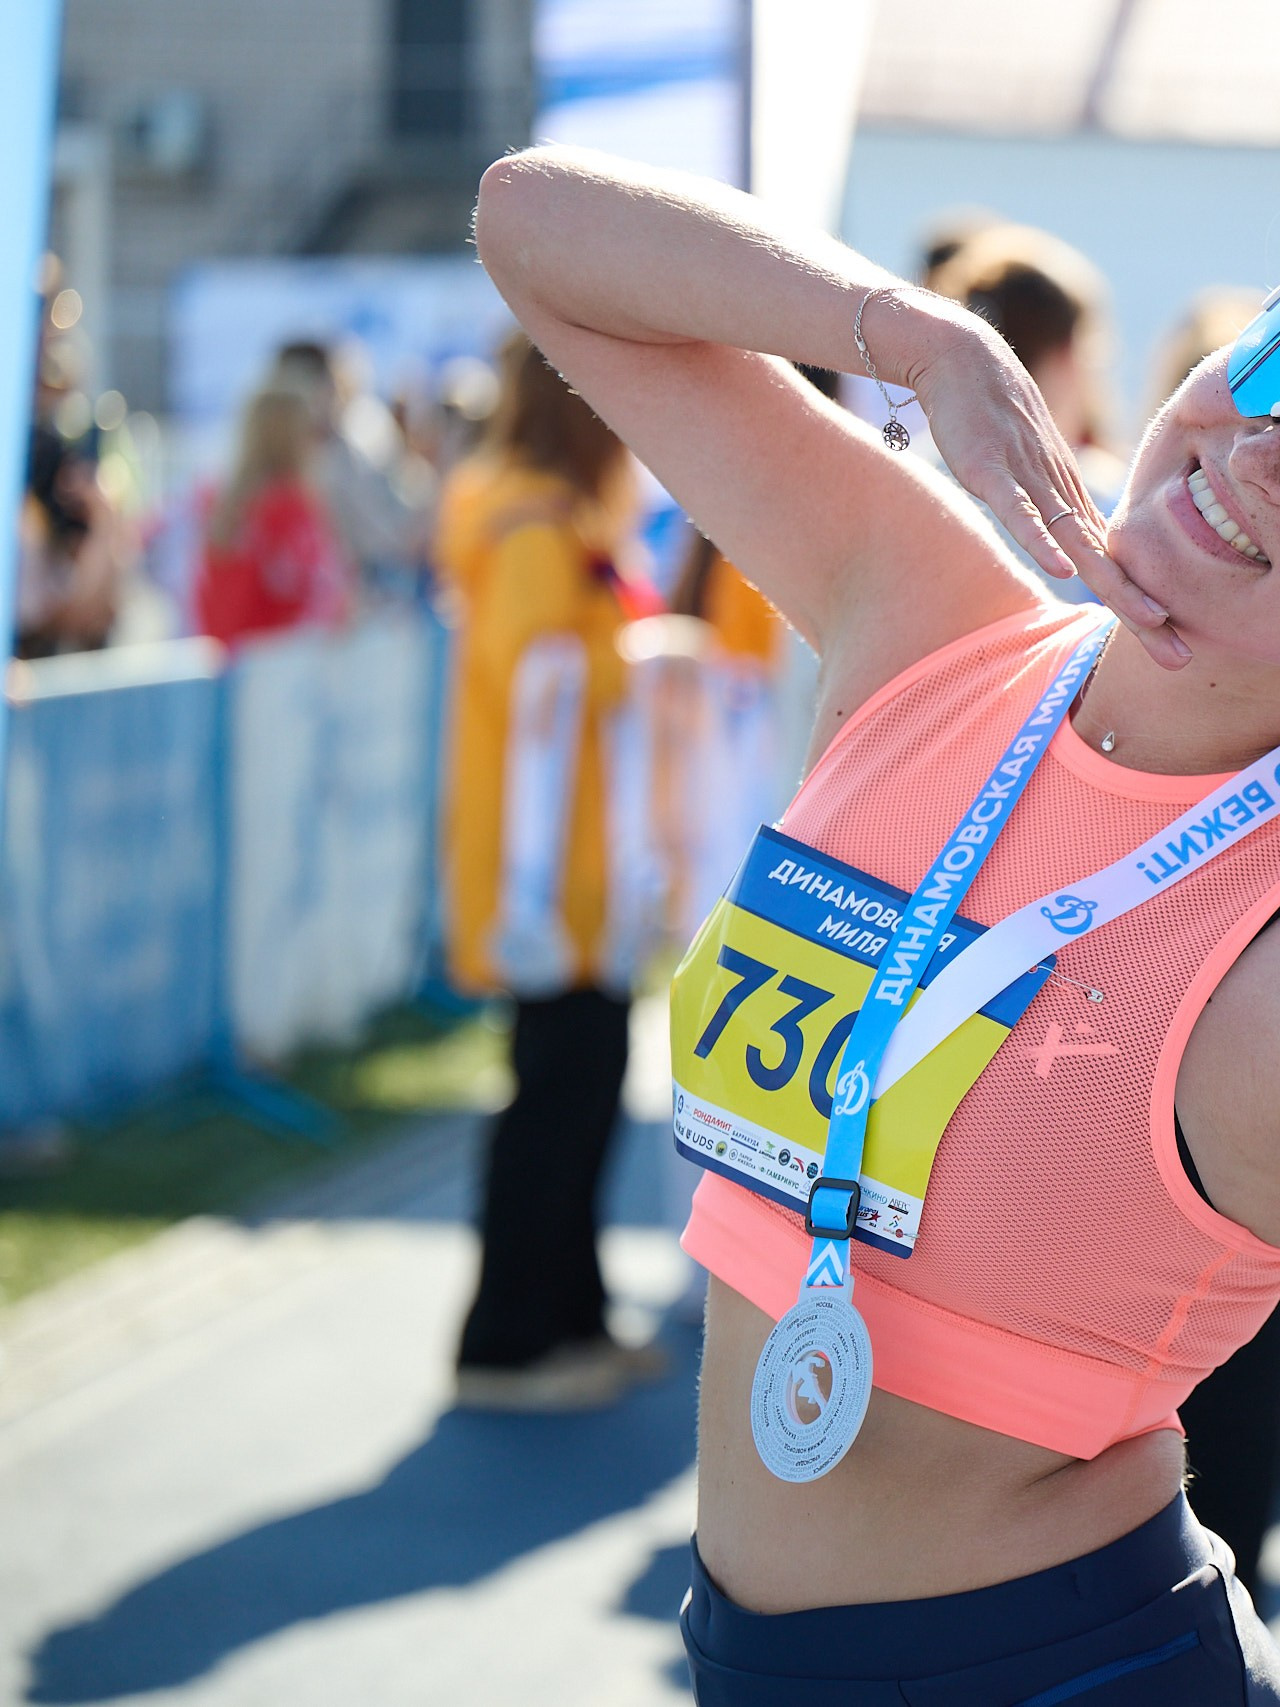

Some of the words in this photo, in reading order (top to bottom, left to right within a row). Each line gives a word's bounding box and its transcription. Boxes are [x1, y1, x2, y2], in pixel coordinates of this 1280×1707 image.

[875, 734, 1043, 1006] ДИНАМОВСКАЯ
[1029, 637, 1096, 727] МИЛЯ
[1136, 780, 1275, 885] БЕЖИТ!
[768, 858, 957, 953] ДИНАМОВЯ
[816, 914, 888, 957] МИЛЯ
[692, 1132, 714, 1150] UDS
[732, 1130, 760, 1147] БАРРАКУДА
[766, 1167, 800, 1189] ГАМБРИНУС
[823, 1378, 847, 1434] РОСТОВ-НА-ДОНУ
